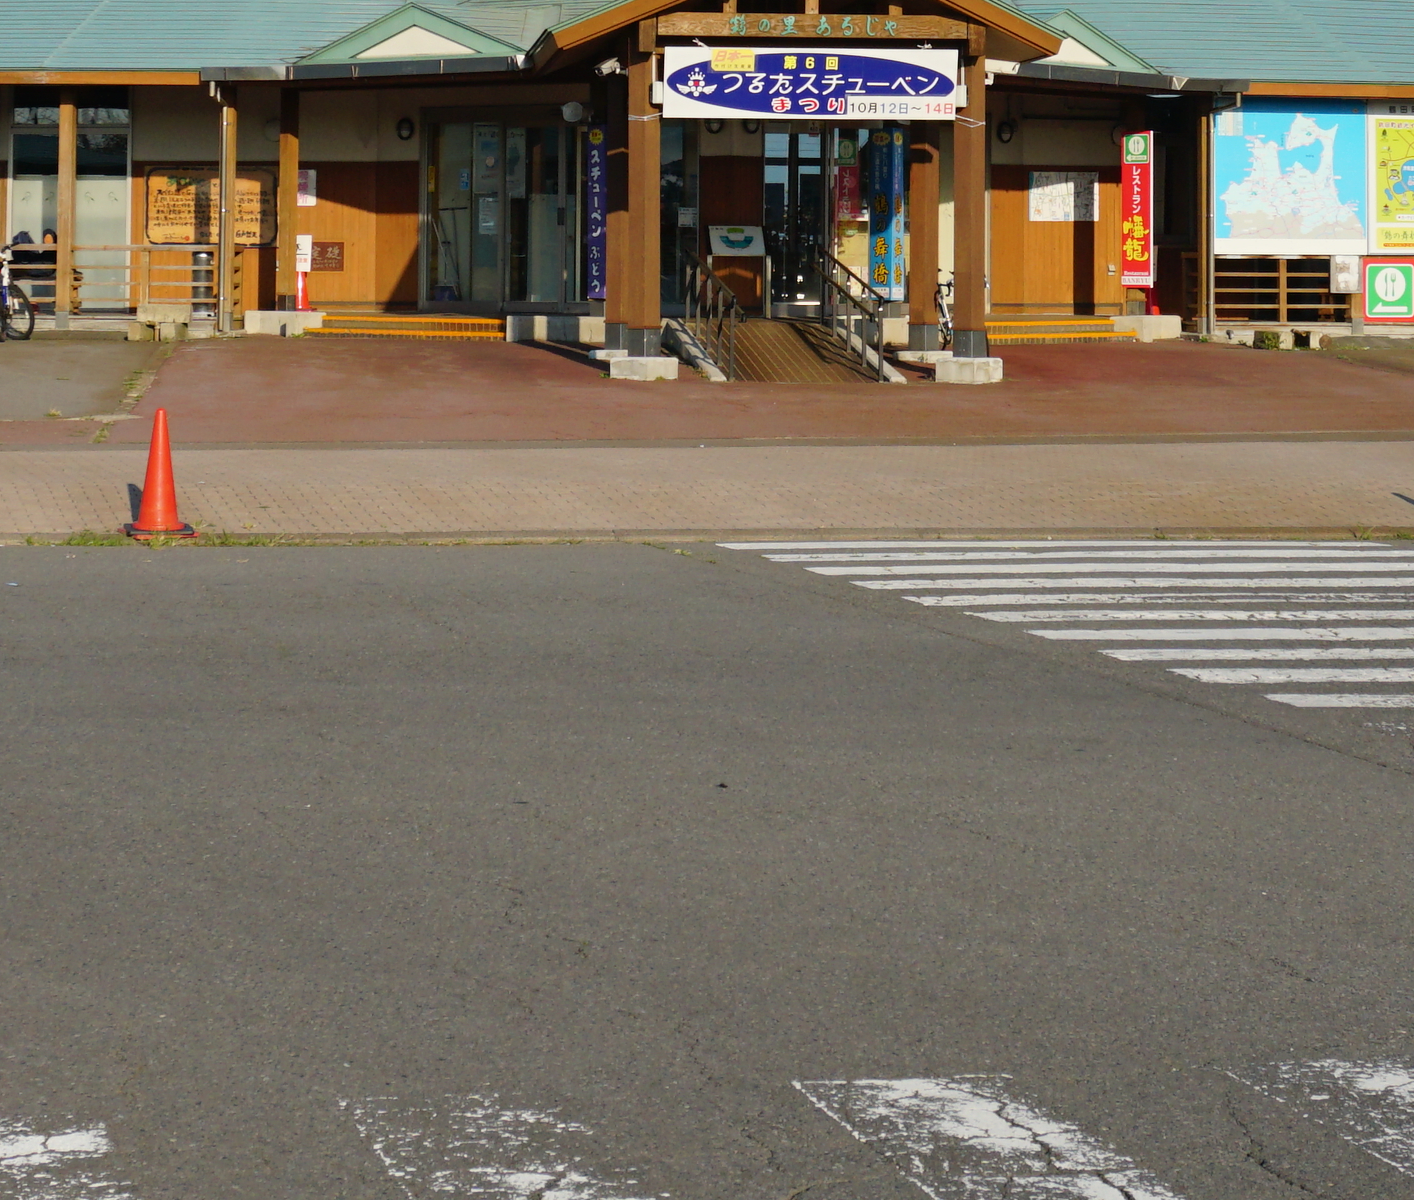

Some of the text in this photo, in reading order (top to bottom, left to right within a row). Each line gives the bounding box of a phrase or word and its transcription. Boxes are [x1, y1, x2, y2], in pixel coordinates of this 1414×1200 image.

[728, 15, 899, 37] 鶴の里 あるじゃ
[713, 50, 753, 62] 日本一
[783, 55, 840, 71] 第6回
[722, 72, 940, 96] つるたスチューベン
[771, 97, 845, 114] まつり
[1131, 165, 1142, 214] レストラン
[590, 149, 602, 293] スチューベン ぶどう
